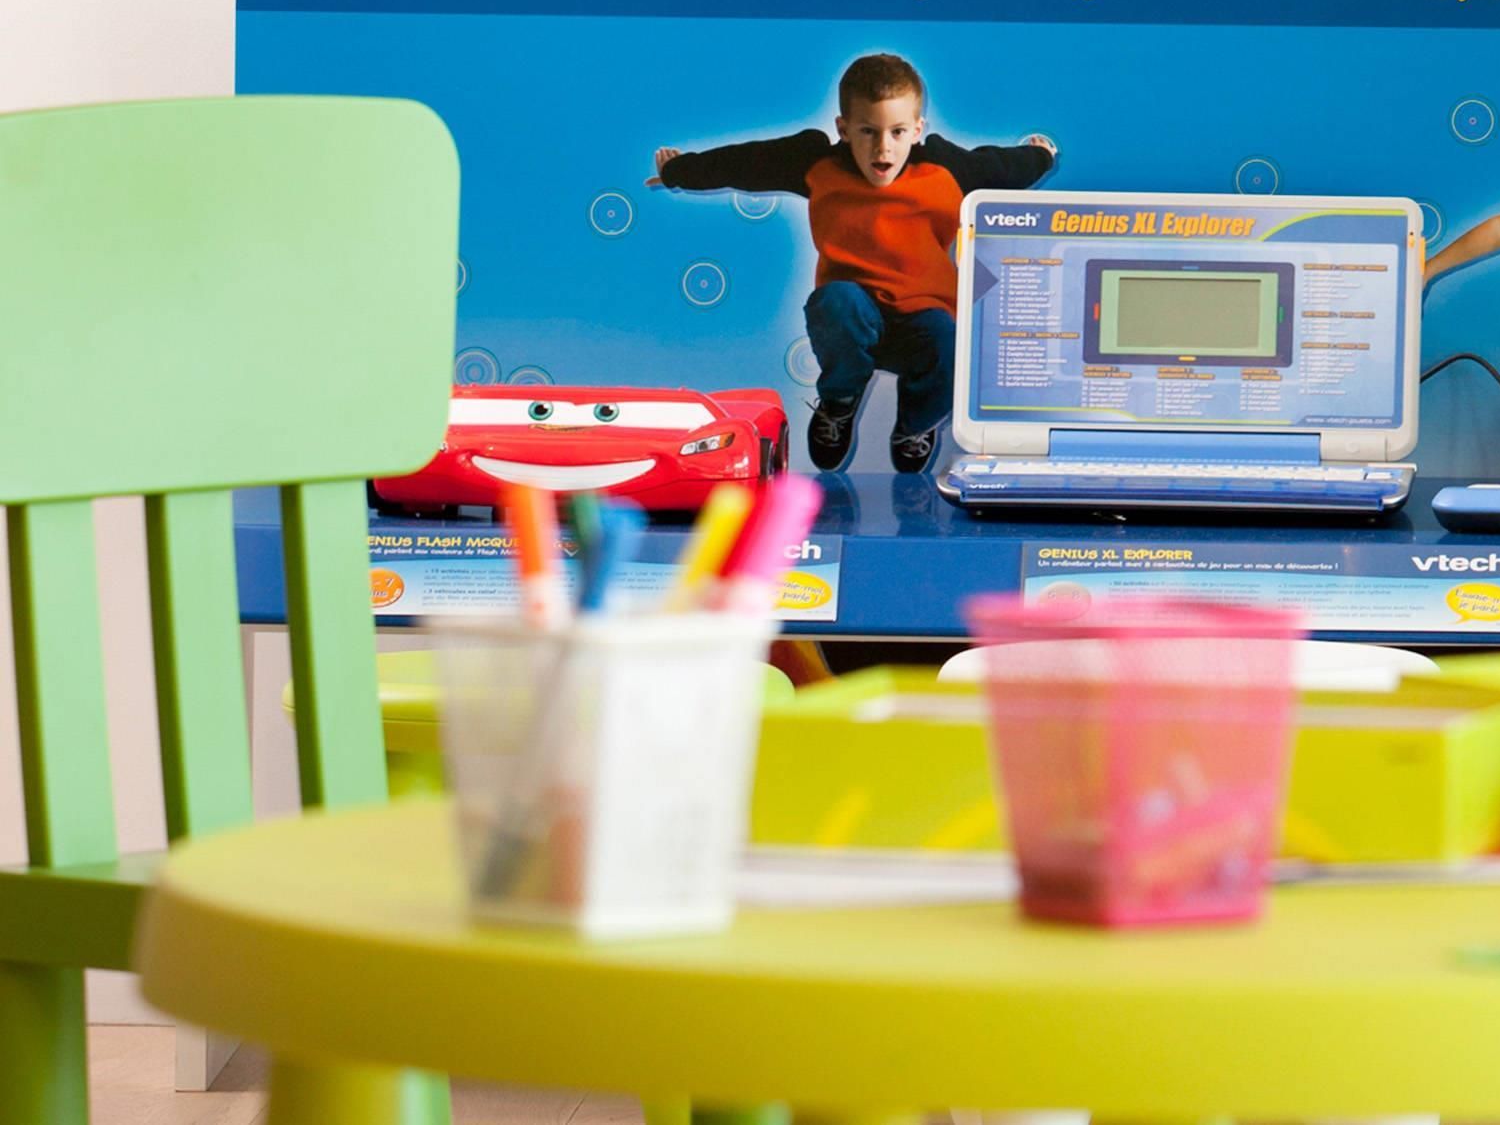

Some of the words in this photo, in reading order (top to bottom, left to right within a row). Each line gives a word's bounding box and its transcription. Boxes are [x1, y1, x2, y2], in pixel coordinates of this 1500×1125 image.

[1050, 209, 1129, 235] Genius
[1132, 211, 1158, 235] XL
[1161, 212, 1258, 238] Explorer
[367, 536, 413, 547] ENIUS
[416, 536, 462, 547] FLASH
[1038, 548, 1098, 559] GENIUS
[1102, 549, 1119, 559] XL
[1123, 549, 1193, 561] EXPLORER
